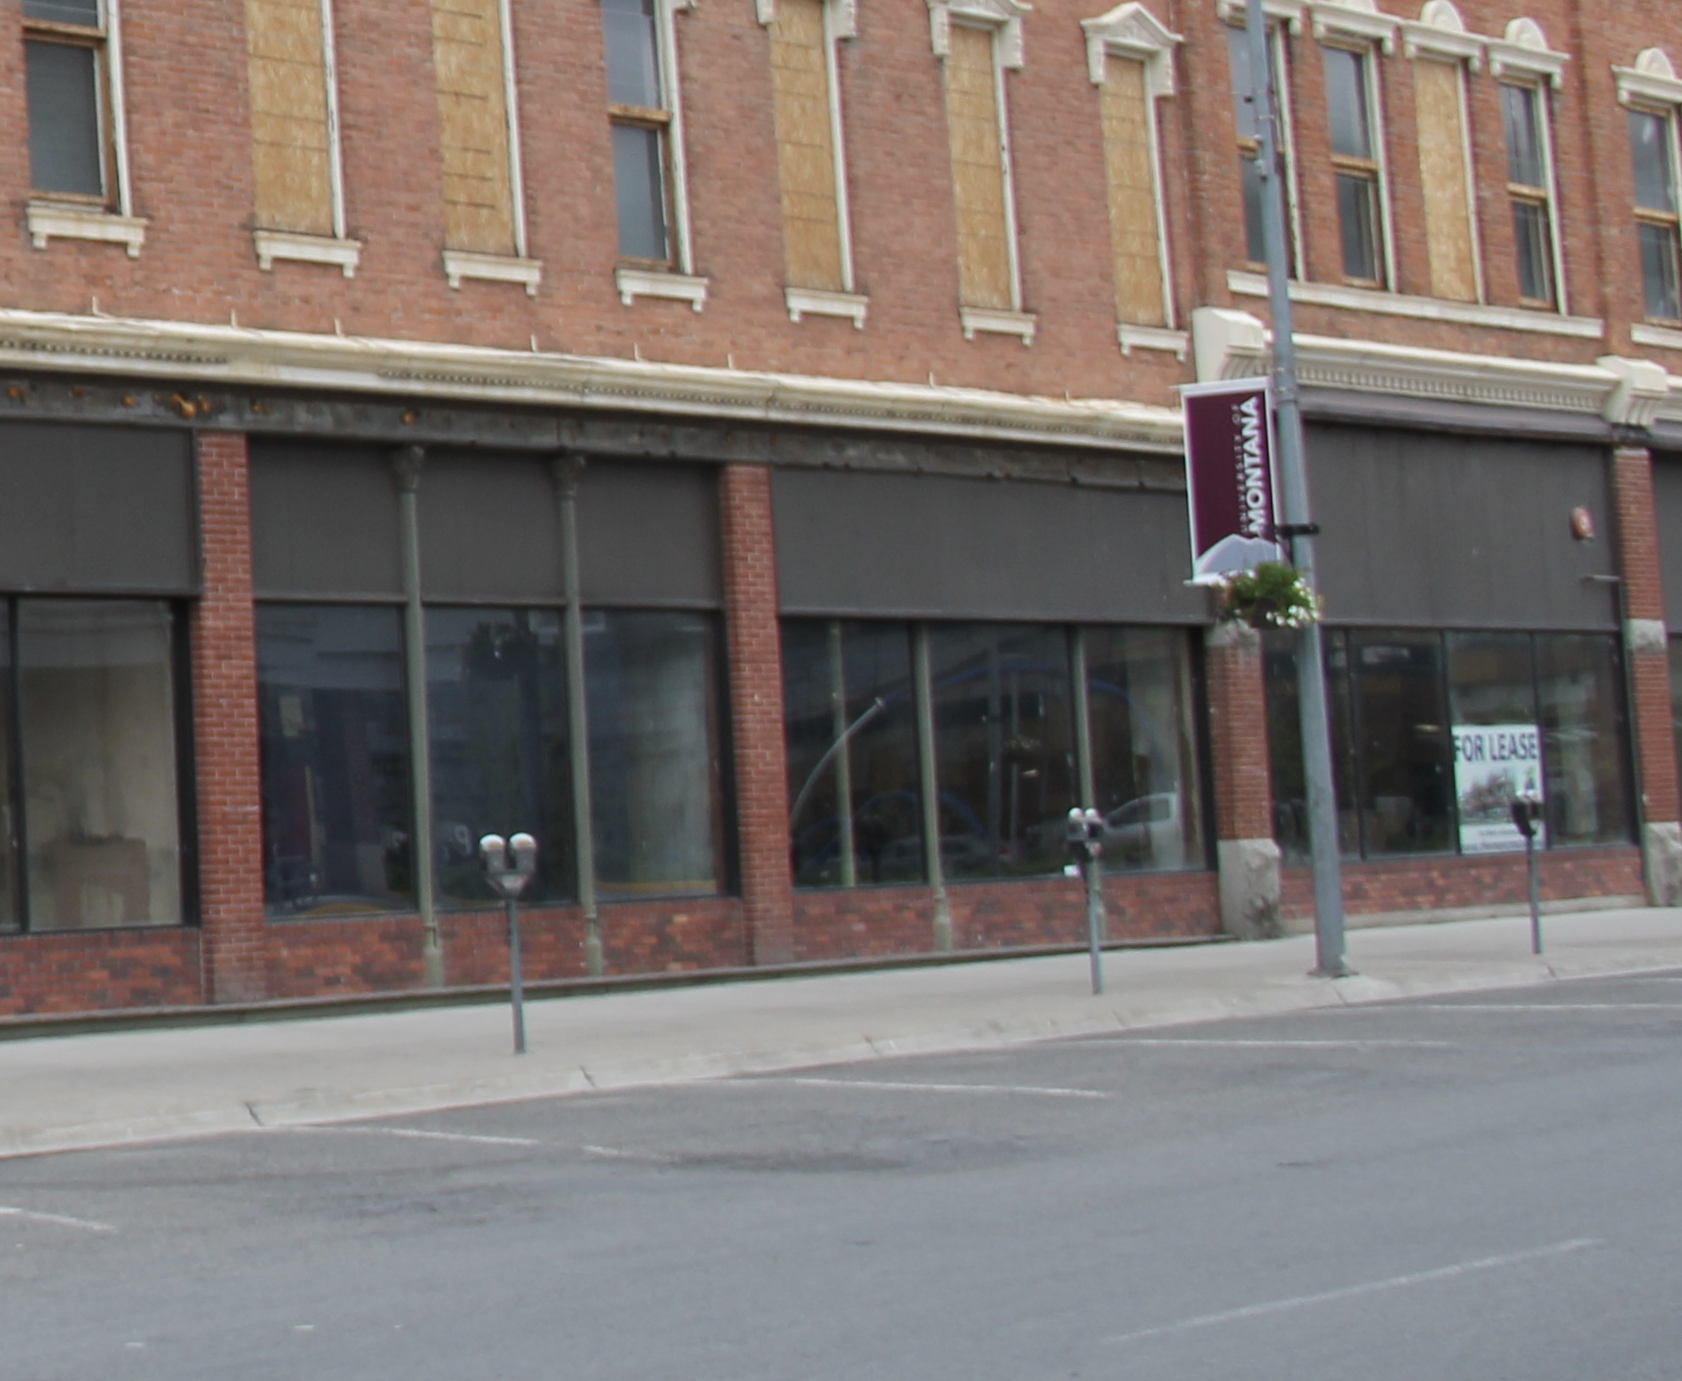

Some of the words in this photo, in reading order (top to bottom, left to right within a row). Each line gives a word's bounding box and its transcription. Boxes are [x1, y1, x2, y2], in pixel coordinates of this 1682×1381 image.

[1233, 433, 1249, 534] UNIVERSITY
[1239, 395, 1266, 534] MONTANA
[1452, 733, 1485, 763] FOR
[1488, 733, 1538, 761] LEASE
